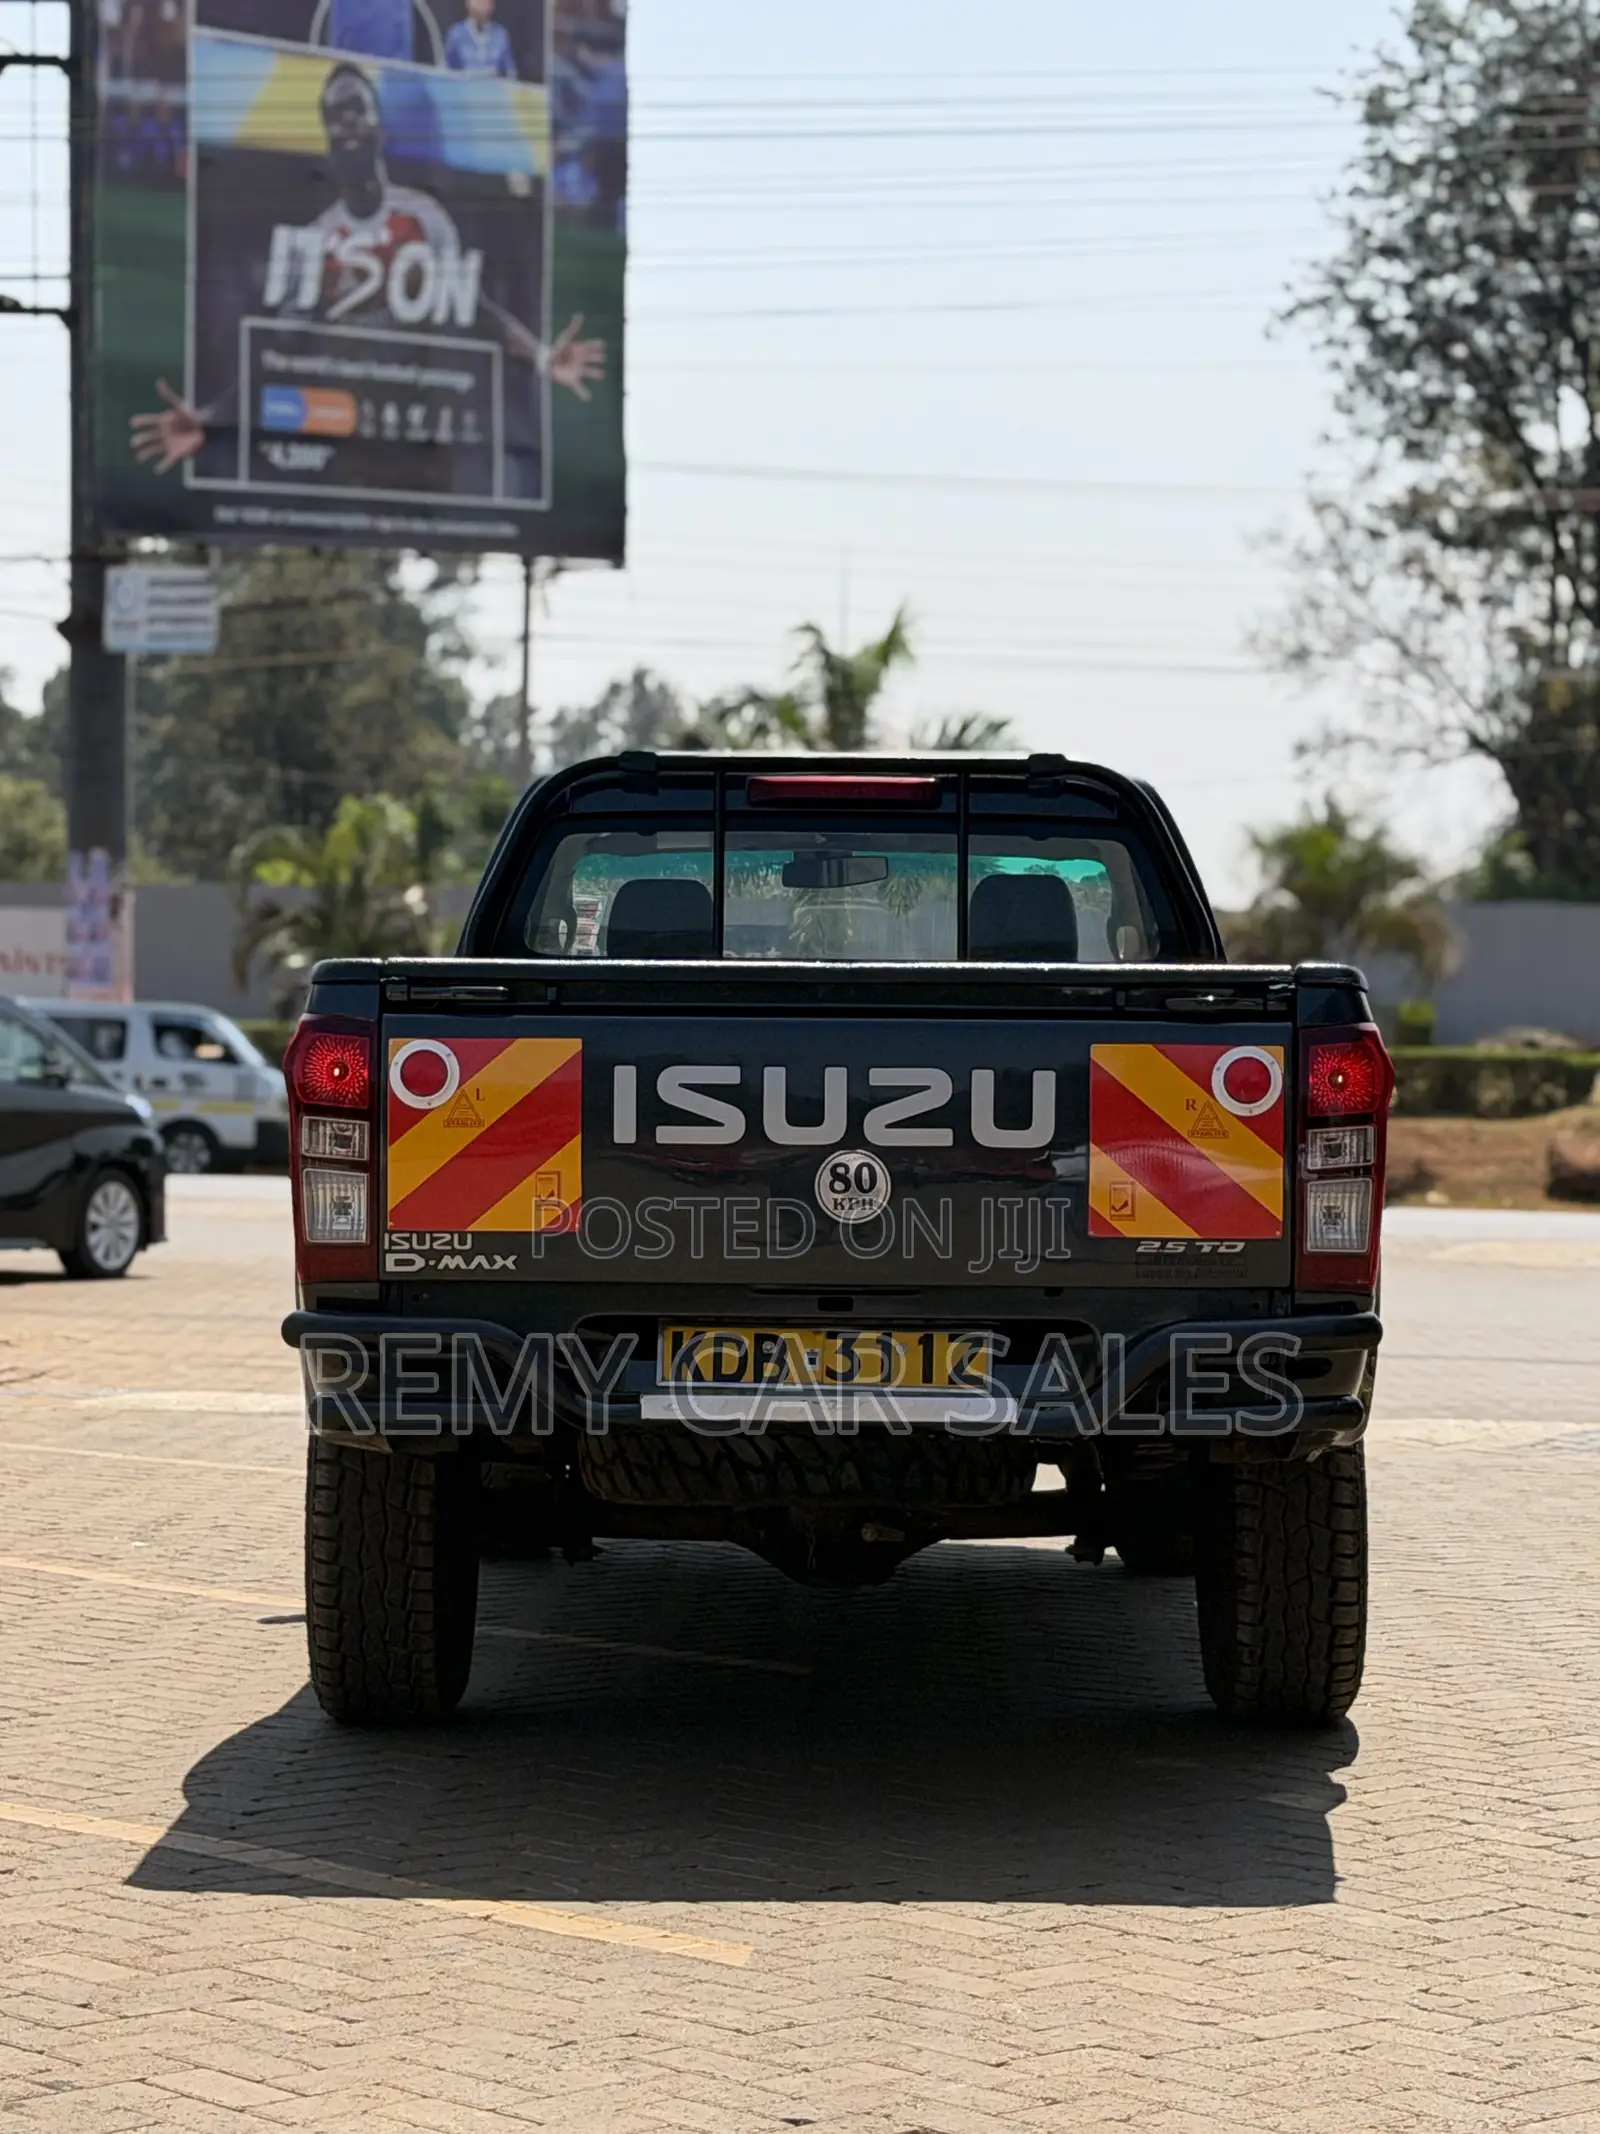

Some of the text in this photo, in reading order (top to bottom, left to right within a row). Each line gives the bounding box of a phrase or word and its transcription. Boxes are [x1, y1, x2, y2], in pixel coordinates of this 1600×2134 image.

[613, 1065, 1056, 1148] ISUZU
[1185, 1098, 1197, 1111] R
[828, 1162, 878, 1194] 80
[831, 1197, 874, 1211] KPH
[384, 1232, 473, 1250] ISUZU
[1195, 1241, 1246, 1253] TD
